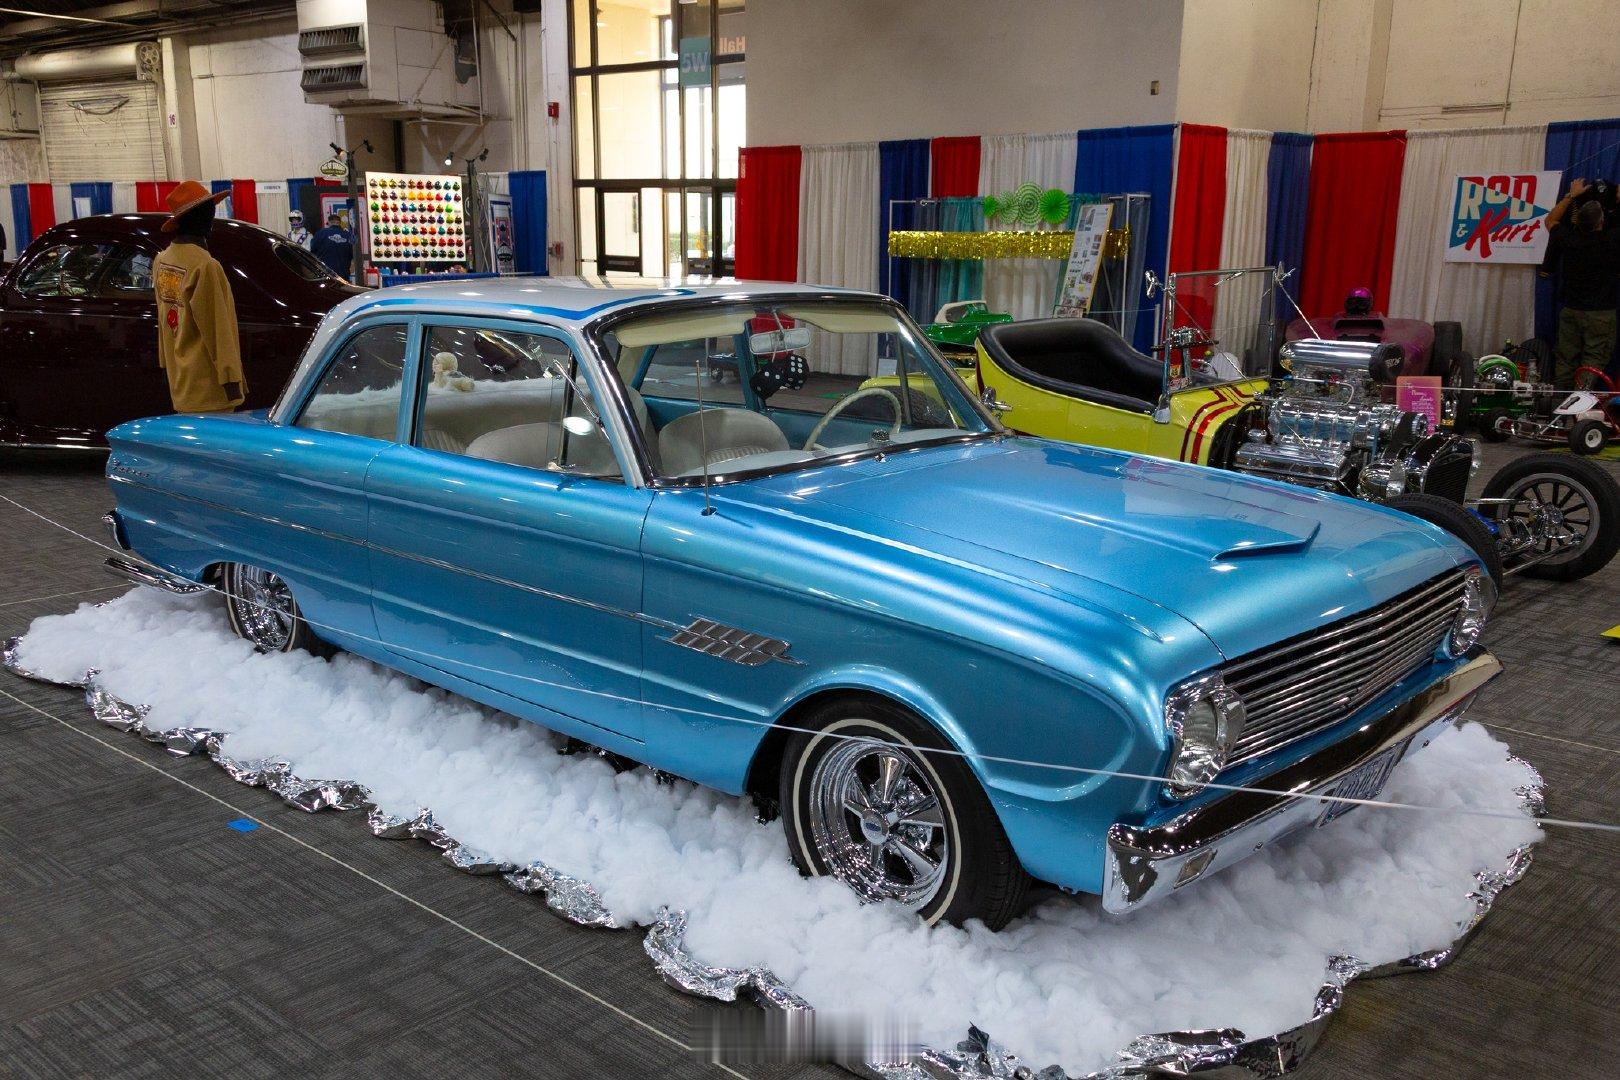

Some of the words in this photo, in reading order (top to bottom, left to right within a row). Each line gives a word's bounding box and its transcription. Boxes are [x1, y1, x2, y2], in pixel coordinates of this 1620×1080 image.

[1458, 175, 1537, 220] ROD
[1456, 224, 1468, 237] &
[1464, 208, 1541, 258] Kart
